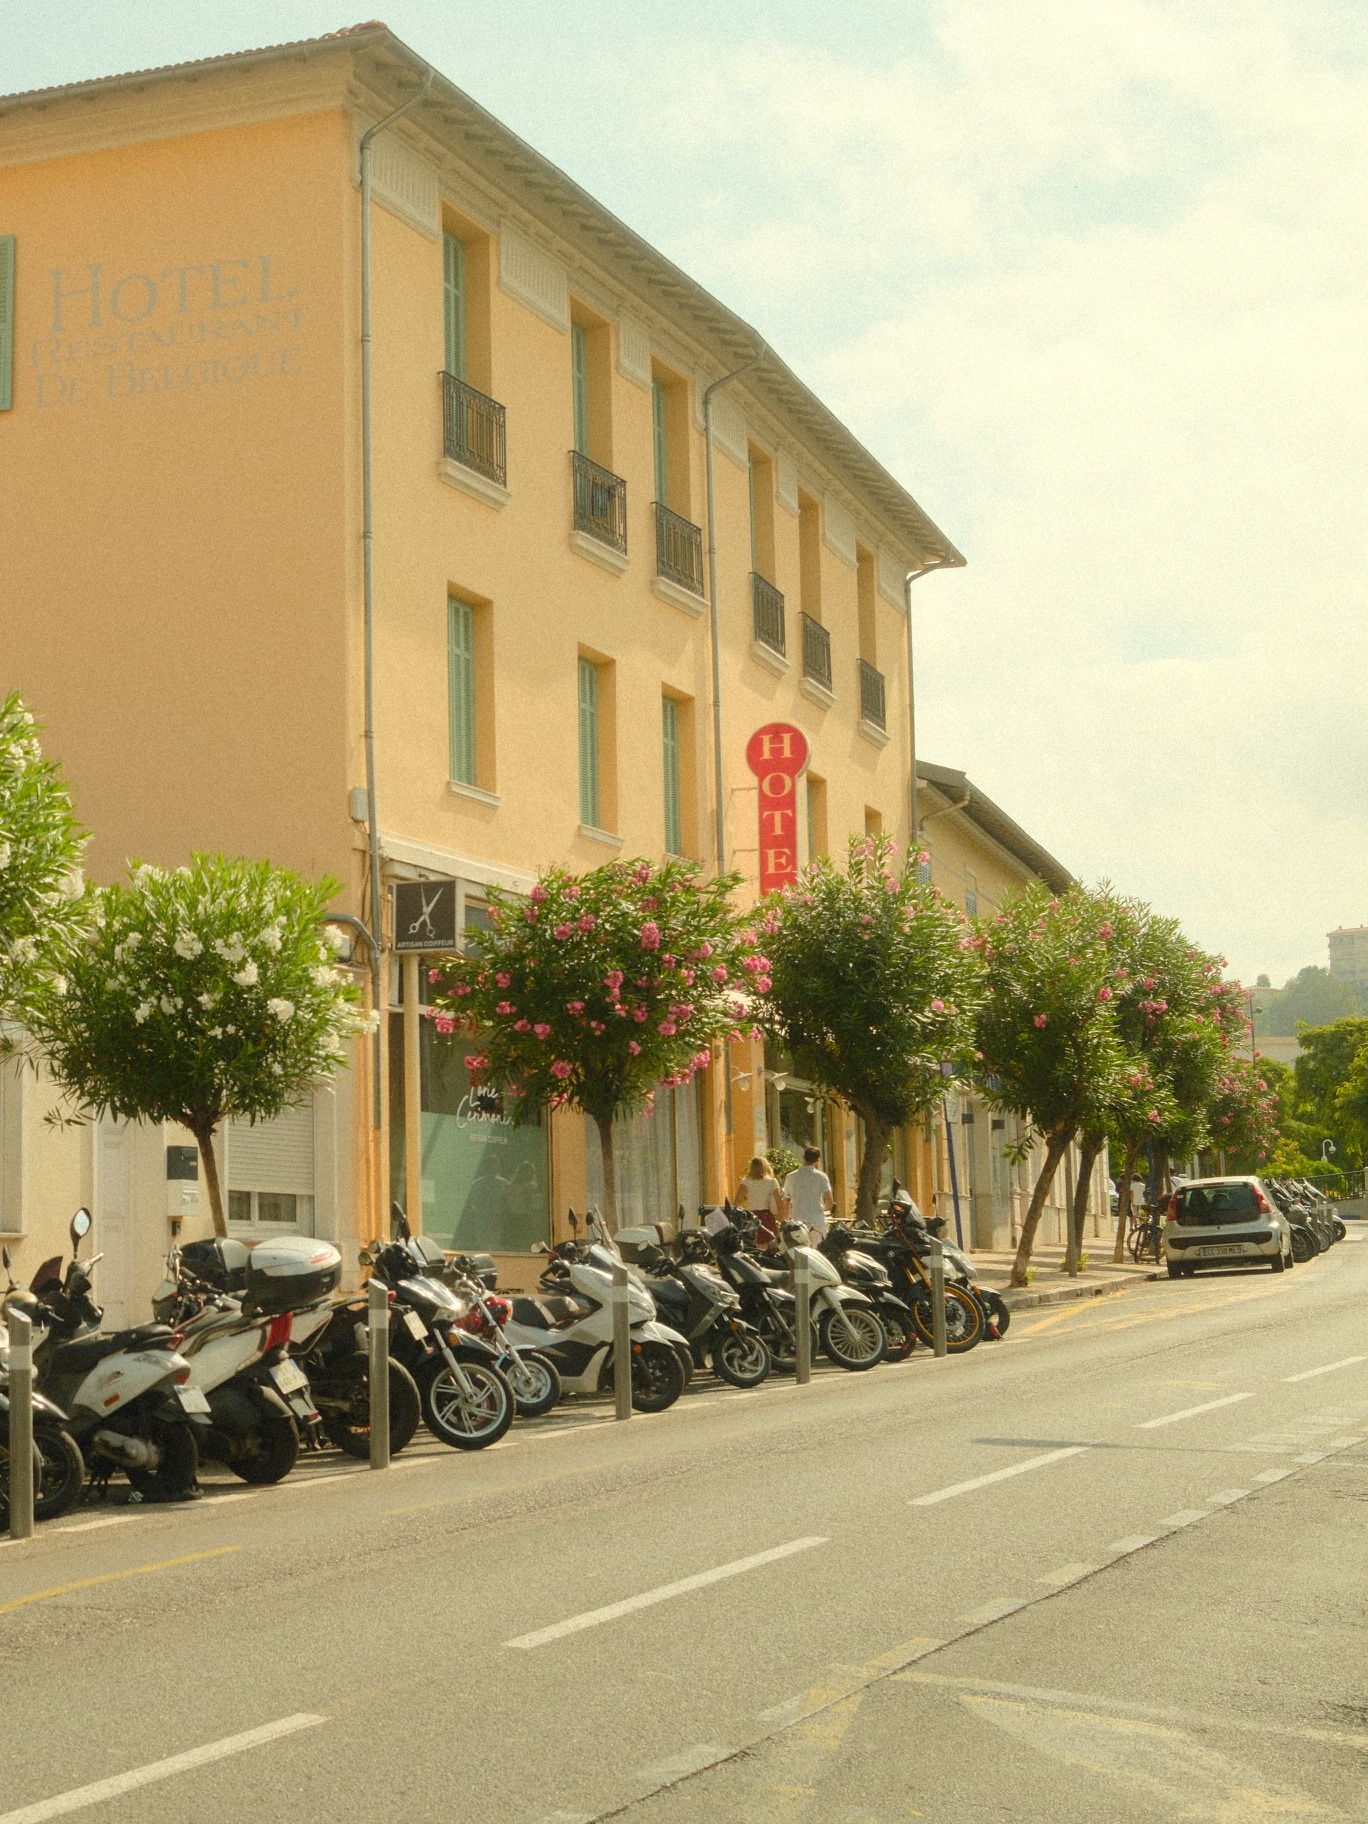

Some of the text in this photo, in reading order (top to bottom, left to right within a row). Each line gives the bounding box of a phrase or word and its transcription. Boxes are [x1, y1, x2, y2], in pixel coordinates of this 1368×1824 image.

[49, 255, 301, 334] HOTEL
[759, 732, 794, 891] HOTE
[397, 939, 453, 949] ARTISAN COIFFEUR
